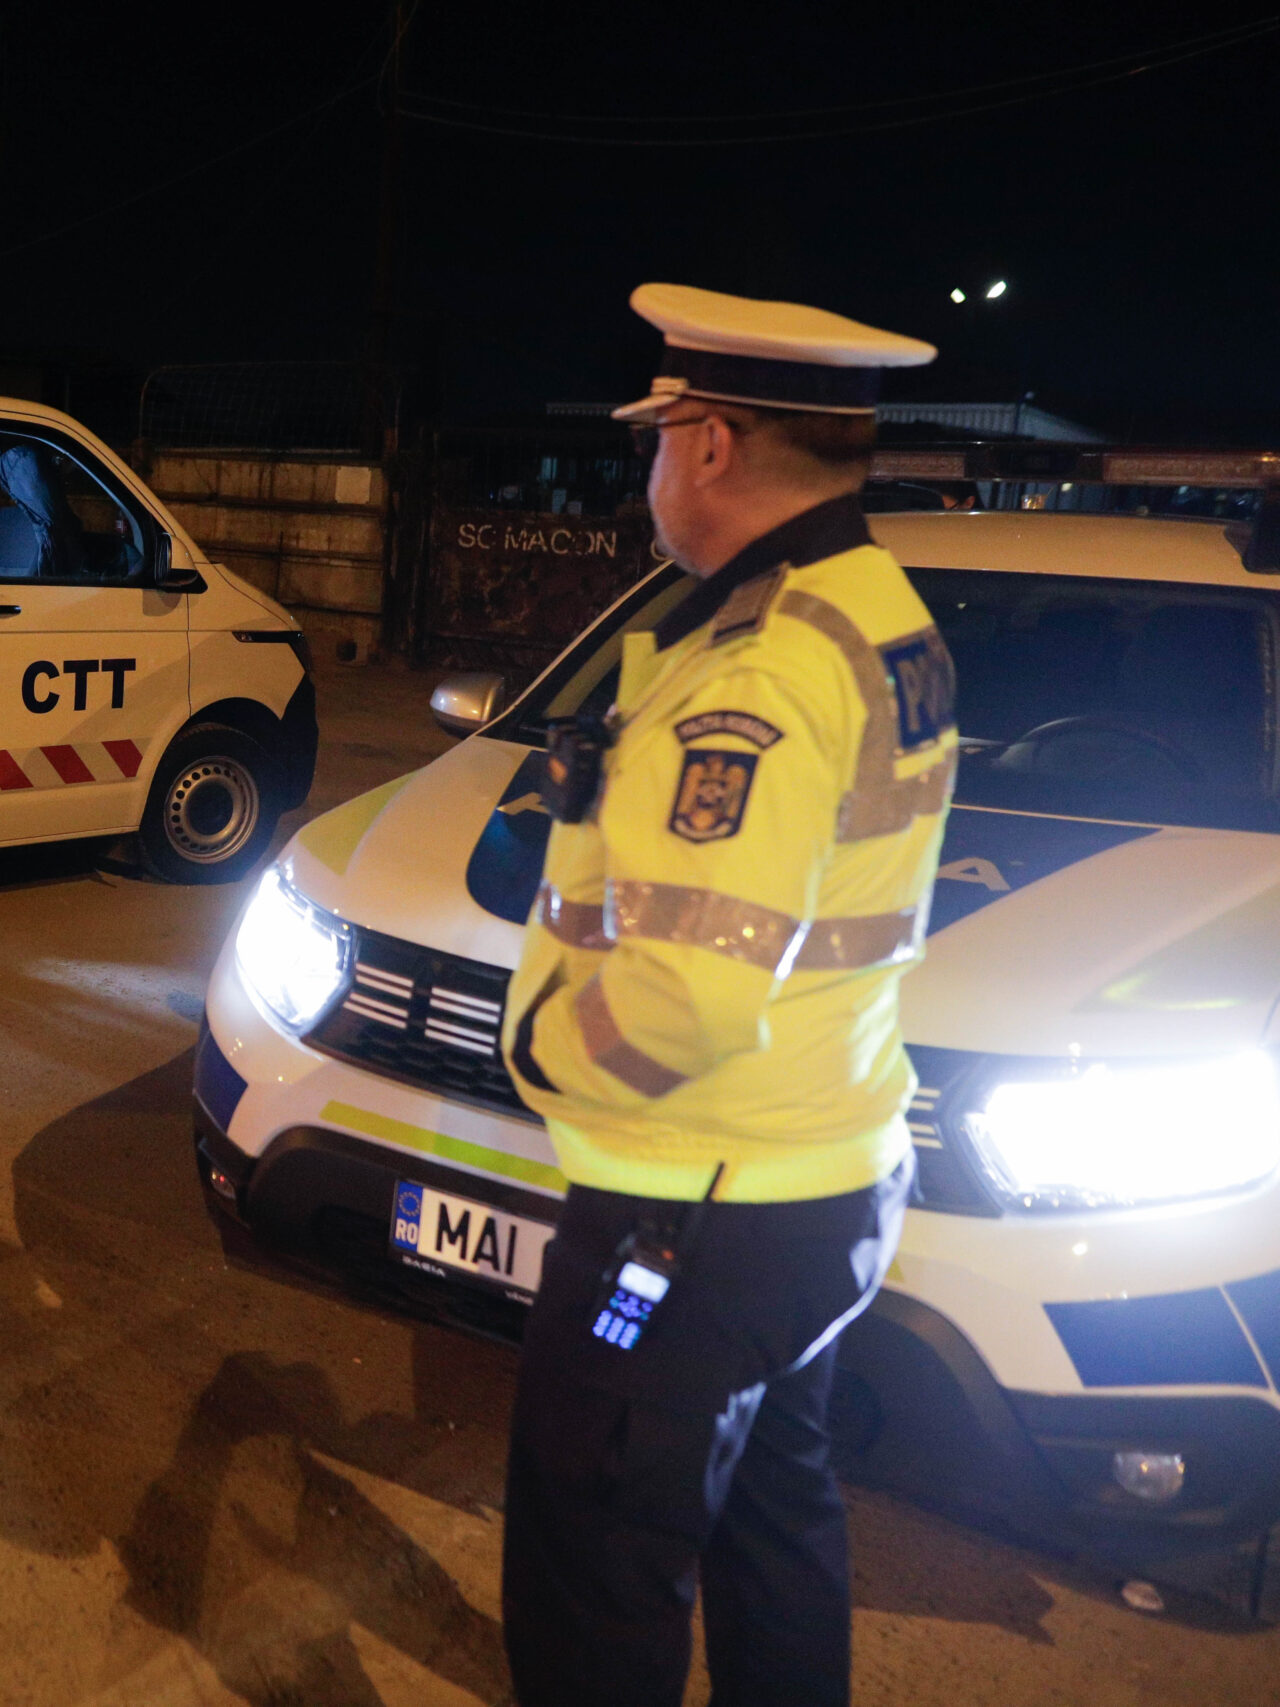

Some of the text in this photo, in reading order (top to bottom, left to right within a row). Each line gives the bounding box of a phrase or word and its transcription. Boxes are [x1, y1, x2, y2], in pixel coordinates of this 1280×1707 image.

[22, 658, 136, 713] CTT
[395, 1202, 517, 1277] RO MAI
